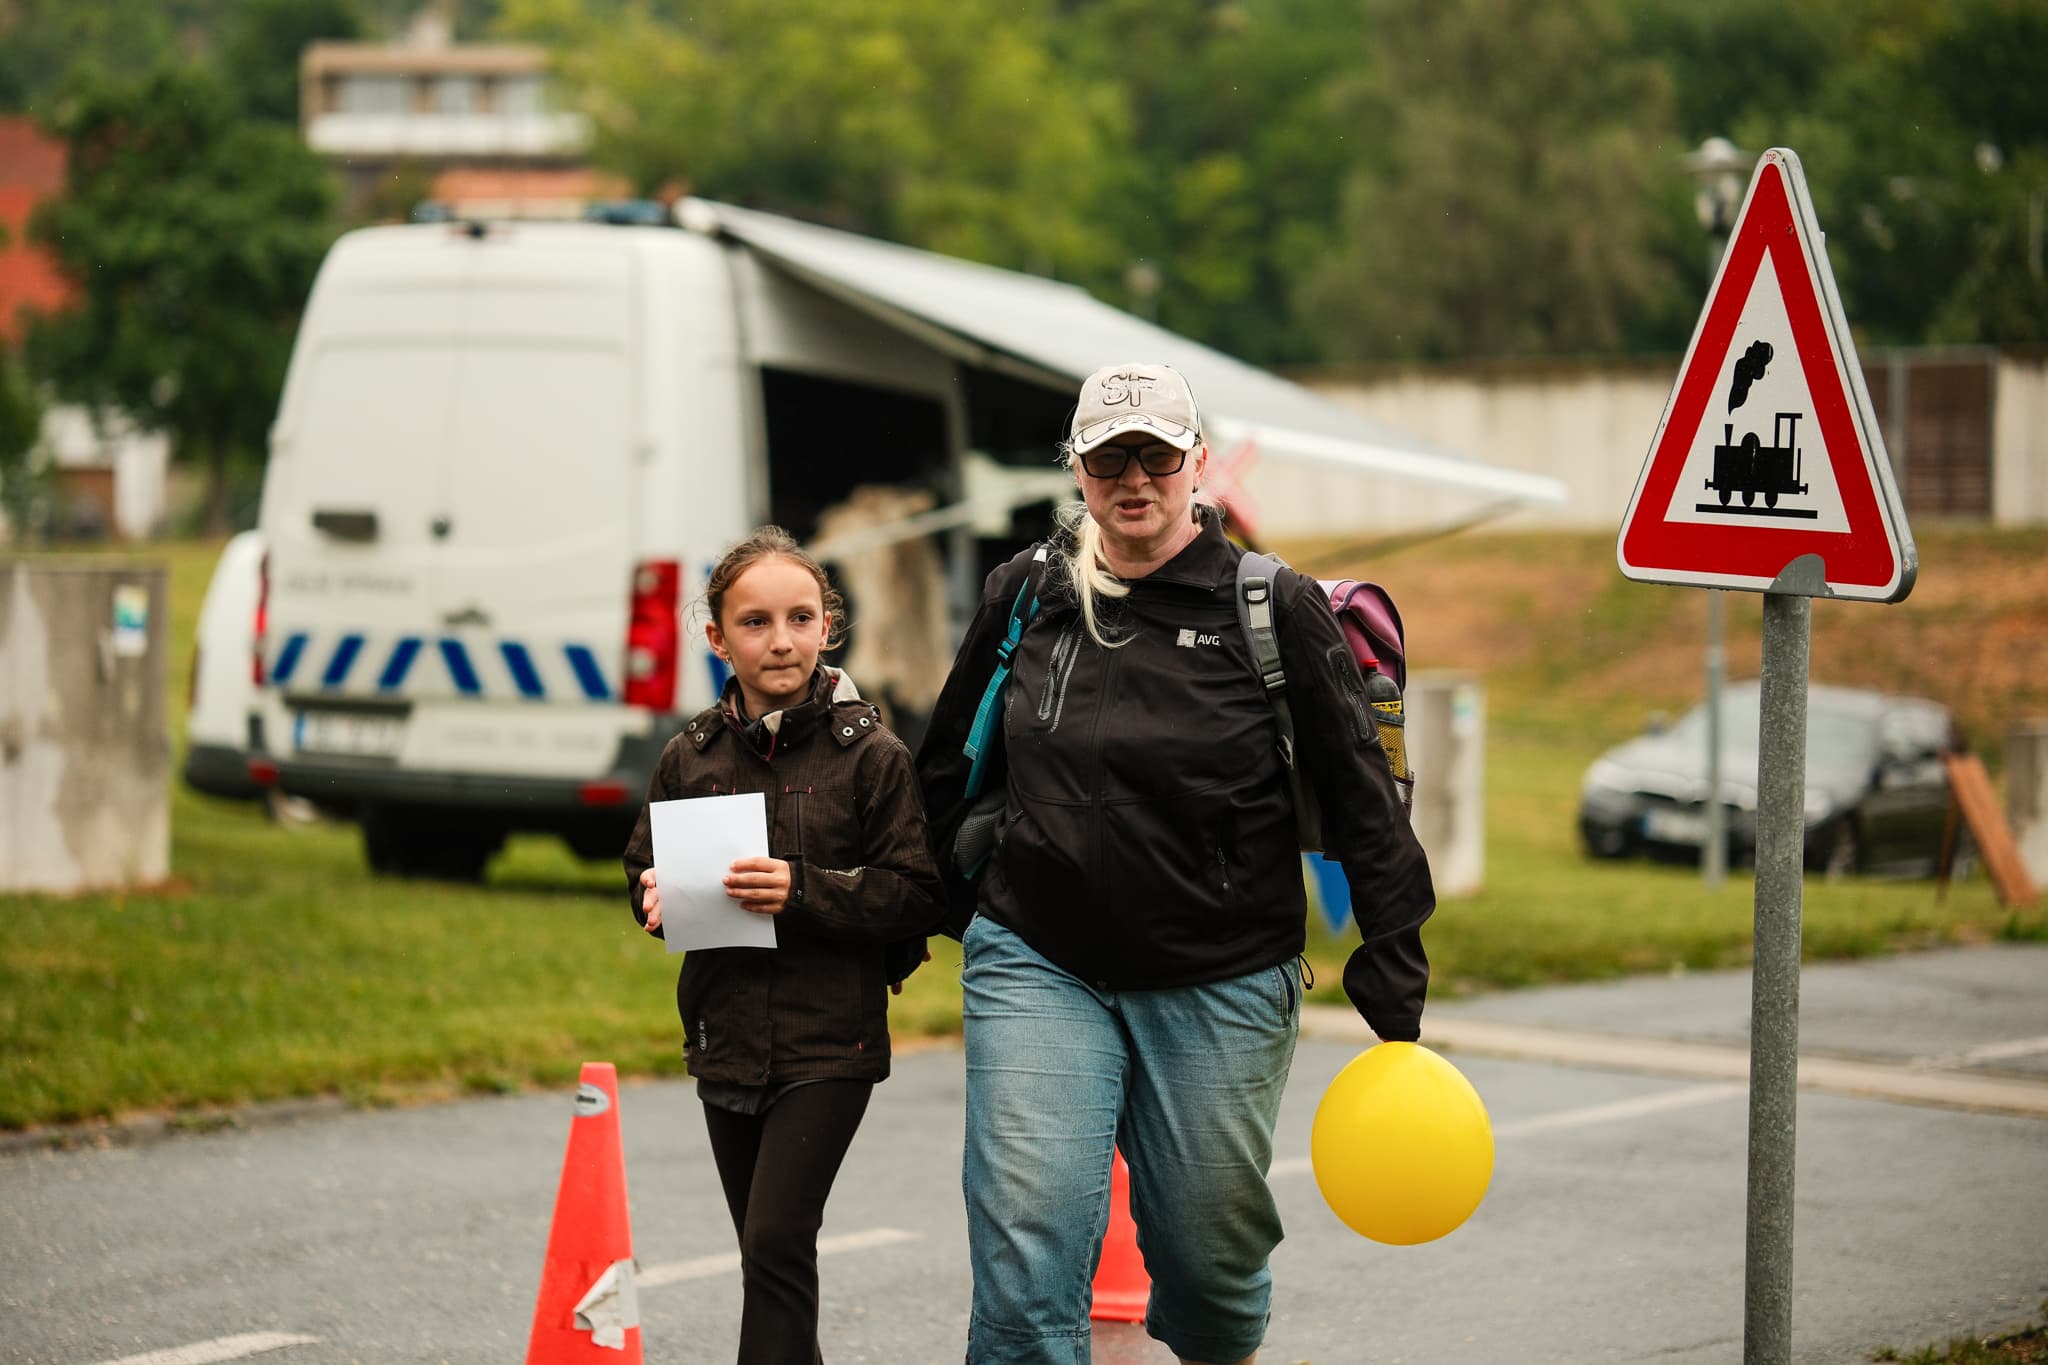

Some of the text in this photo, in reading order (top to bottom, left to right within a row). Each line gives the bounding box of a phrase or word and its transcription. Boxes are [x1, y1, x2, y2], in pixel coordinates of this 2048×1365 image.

[1766, 153, 1776, 162] TOP
[1101, 373, 1156, 407] SF
[1196, 634, 1221, 646] AVG
